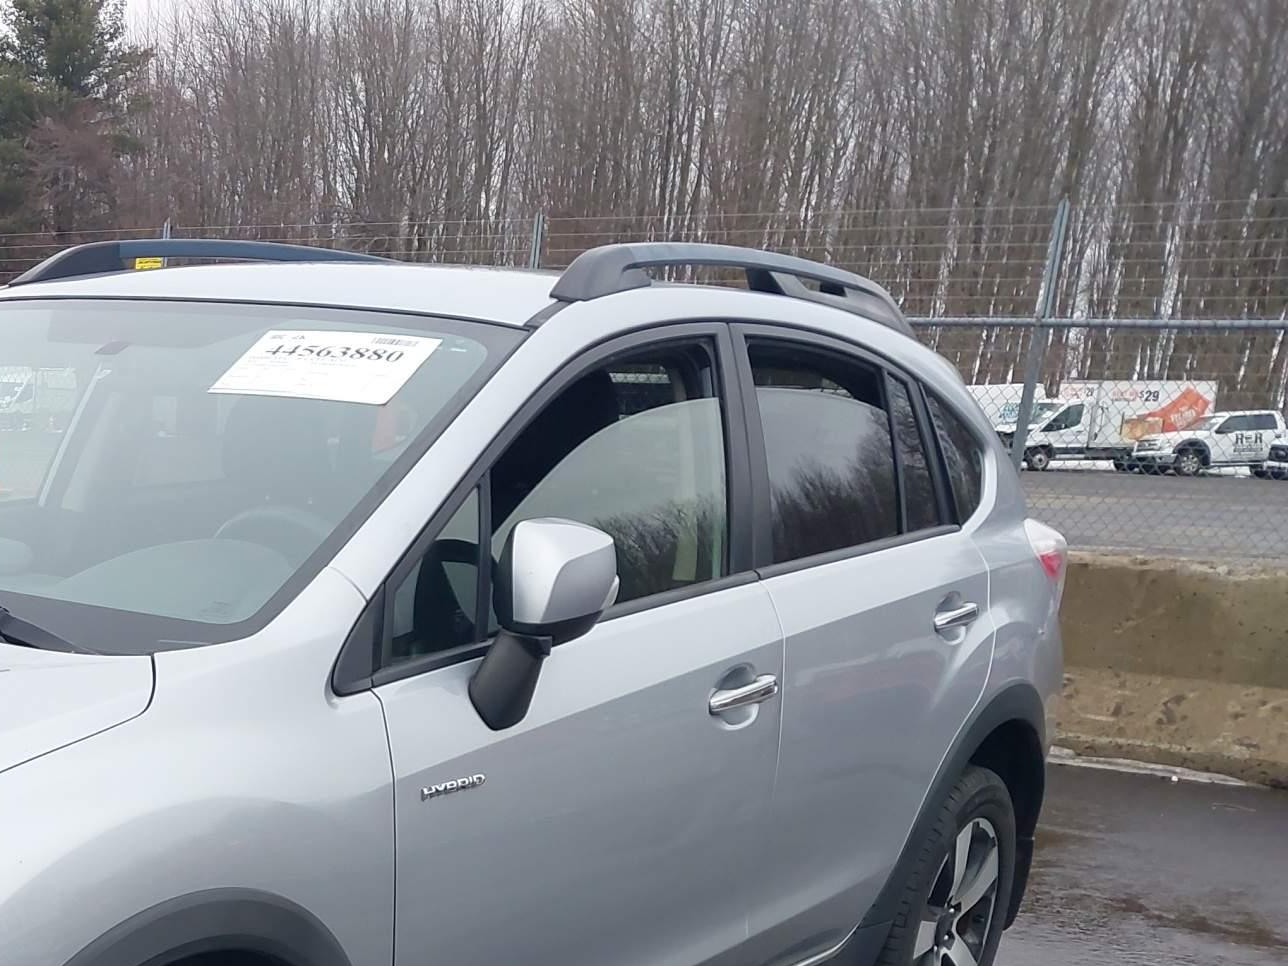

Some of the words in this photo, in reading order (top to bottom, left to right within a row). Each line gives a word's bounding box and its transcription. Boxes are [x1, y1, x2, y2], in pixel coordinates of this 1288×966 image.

[265, 344, 405, 363] 44563880
[1139, 389, 1160, 402] $29
[421, 773, 486, 801] HYBRID
